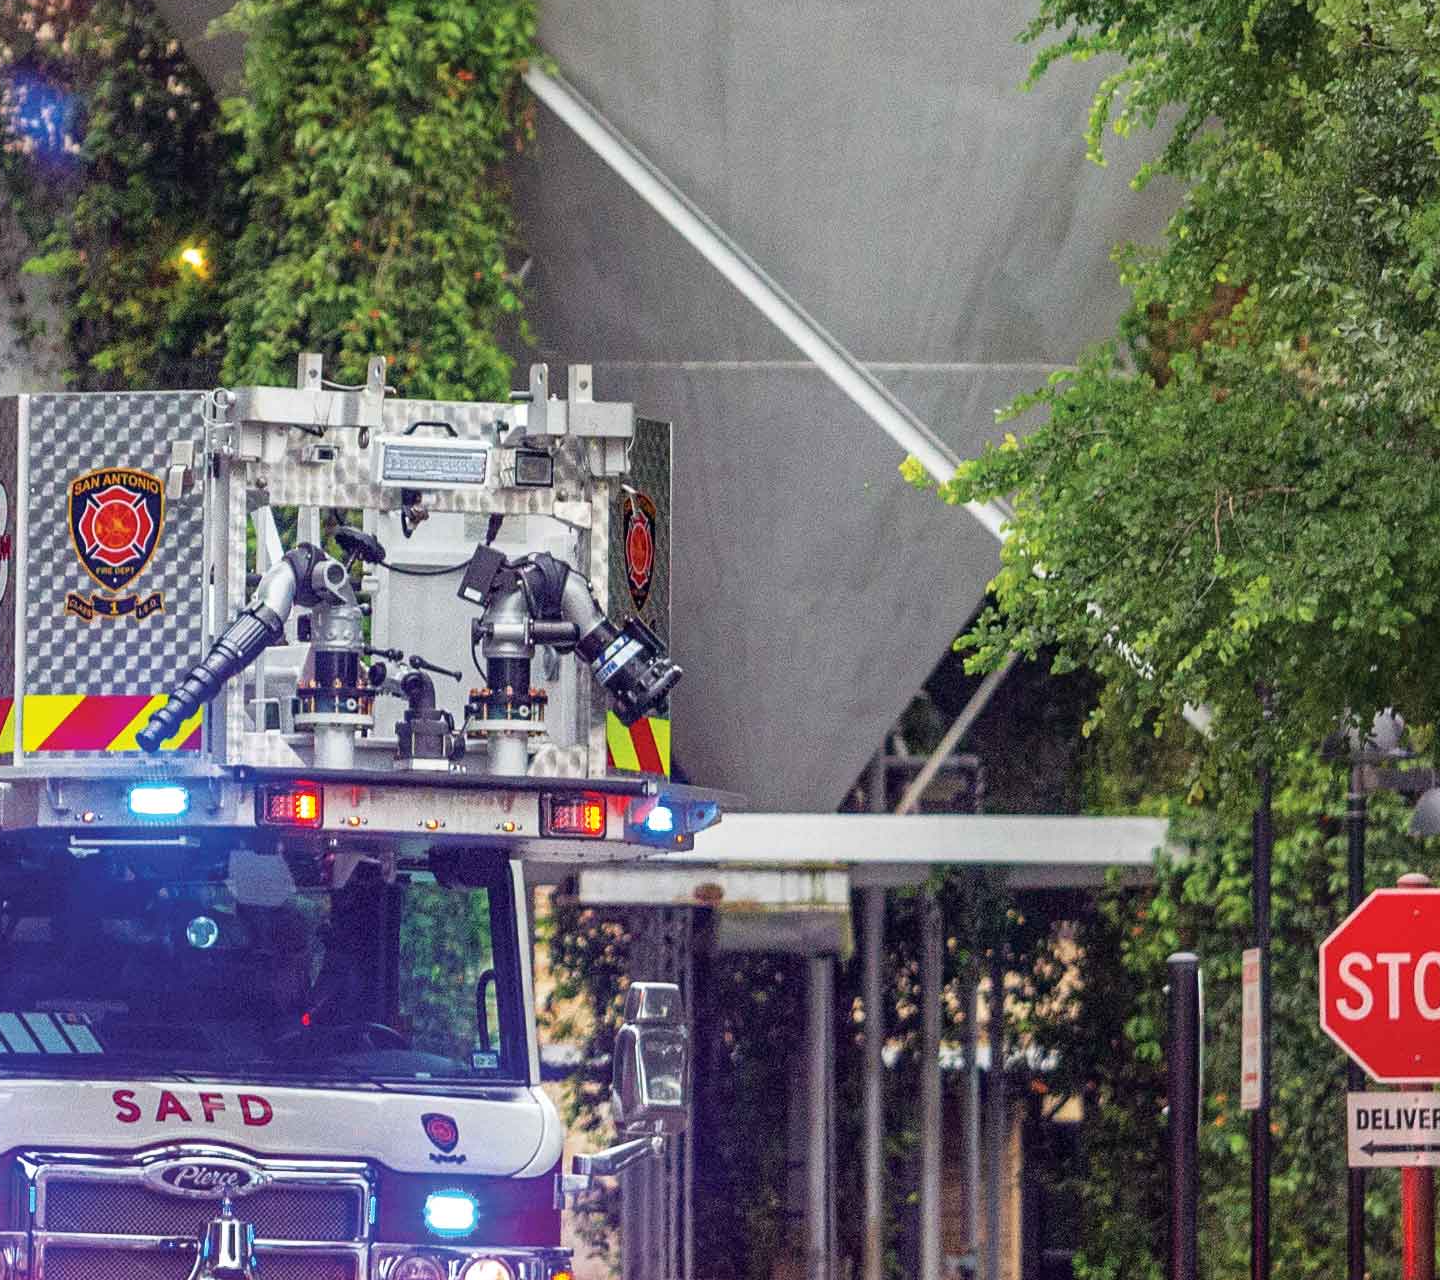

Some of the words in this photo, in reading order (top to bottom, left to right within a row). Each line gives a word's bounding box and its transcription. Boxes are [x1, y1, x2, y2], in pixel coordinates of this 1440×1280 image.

[74, 473, 100, 495] SAN
[103, 473, 159, 494] ANTONIO
[112, 1089, 274, 1127] SAFD
[173, 1164, 239, 1187] Pierce
